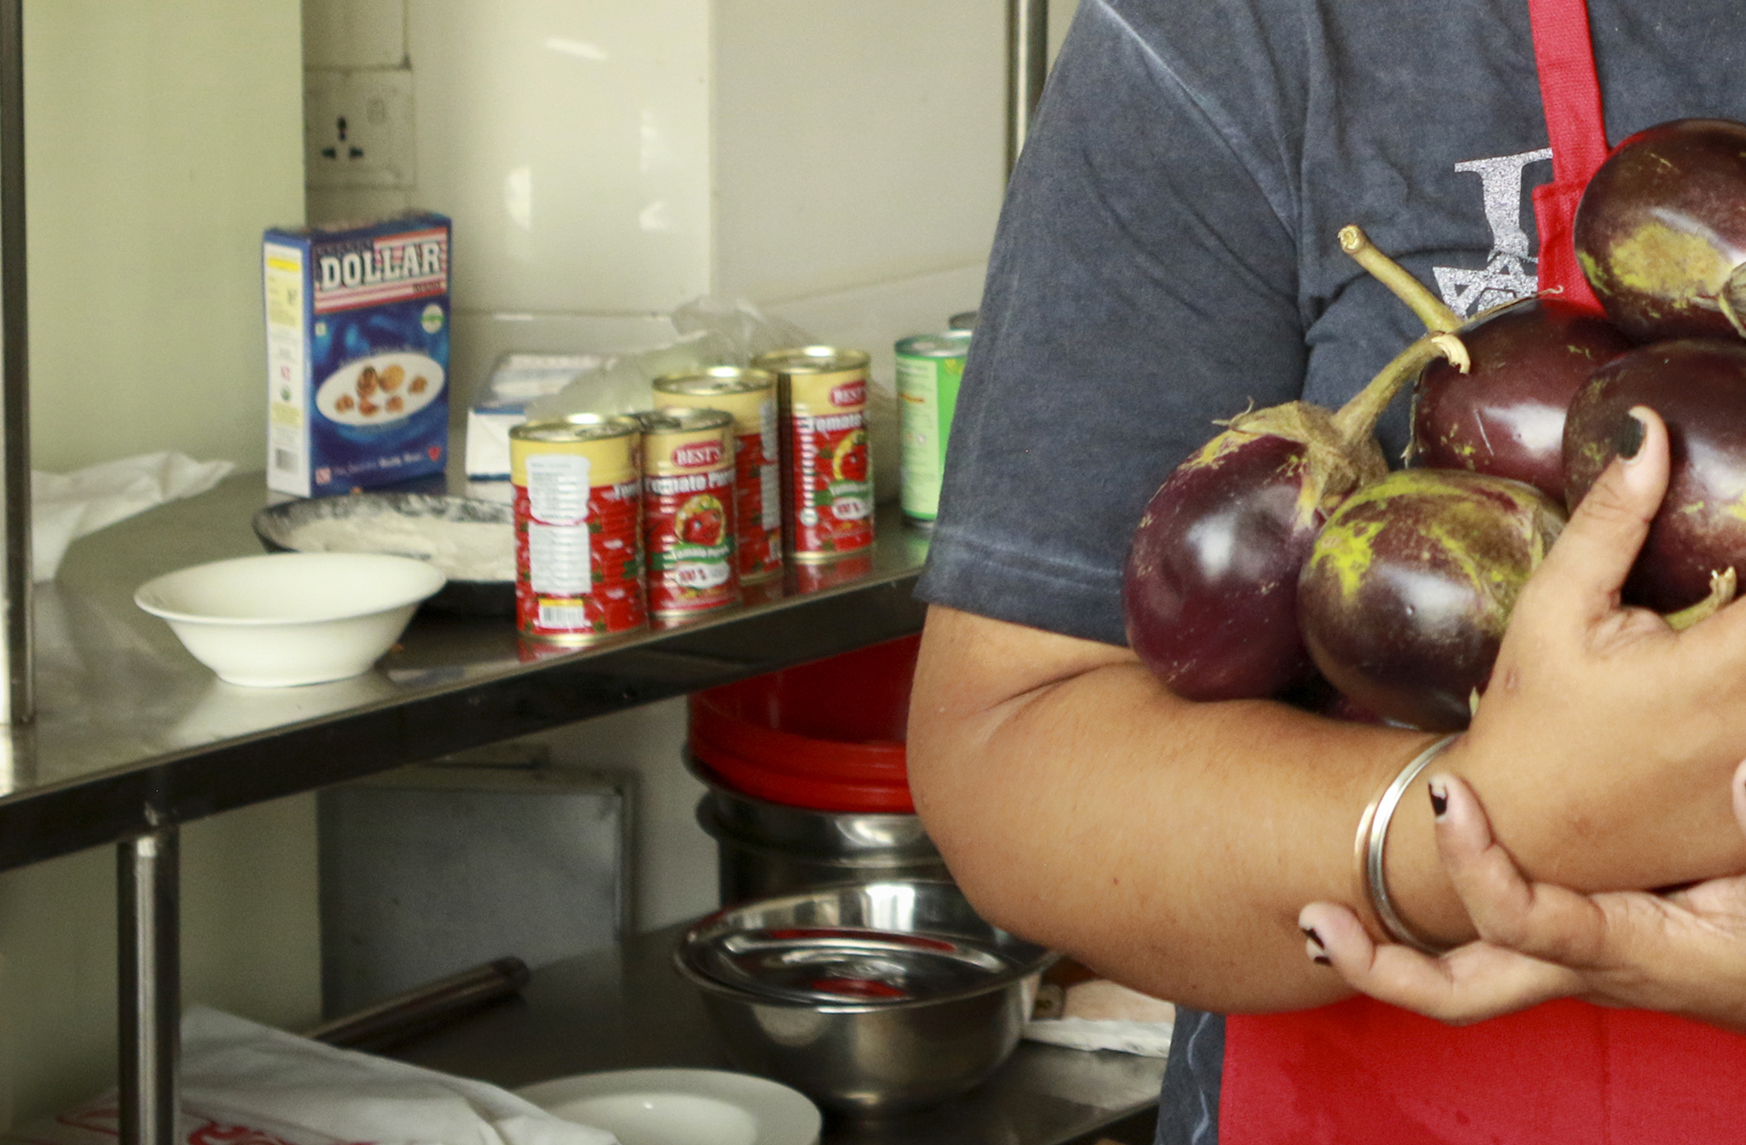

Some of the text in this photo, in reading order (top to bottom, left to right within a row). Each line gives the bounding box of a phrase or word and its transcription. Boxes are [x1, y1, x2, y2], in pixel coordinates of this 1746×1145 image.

[320, 239, 441, 292] DOLLAR
[675, 445, 721, 466] BEST'S
[643, 474, 707, 496] Tomato
